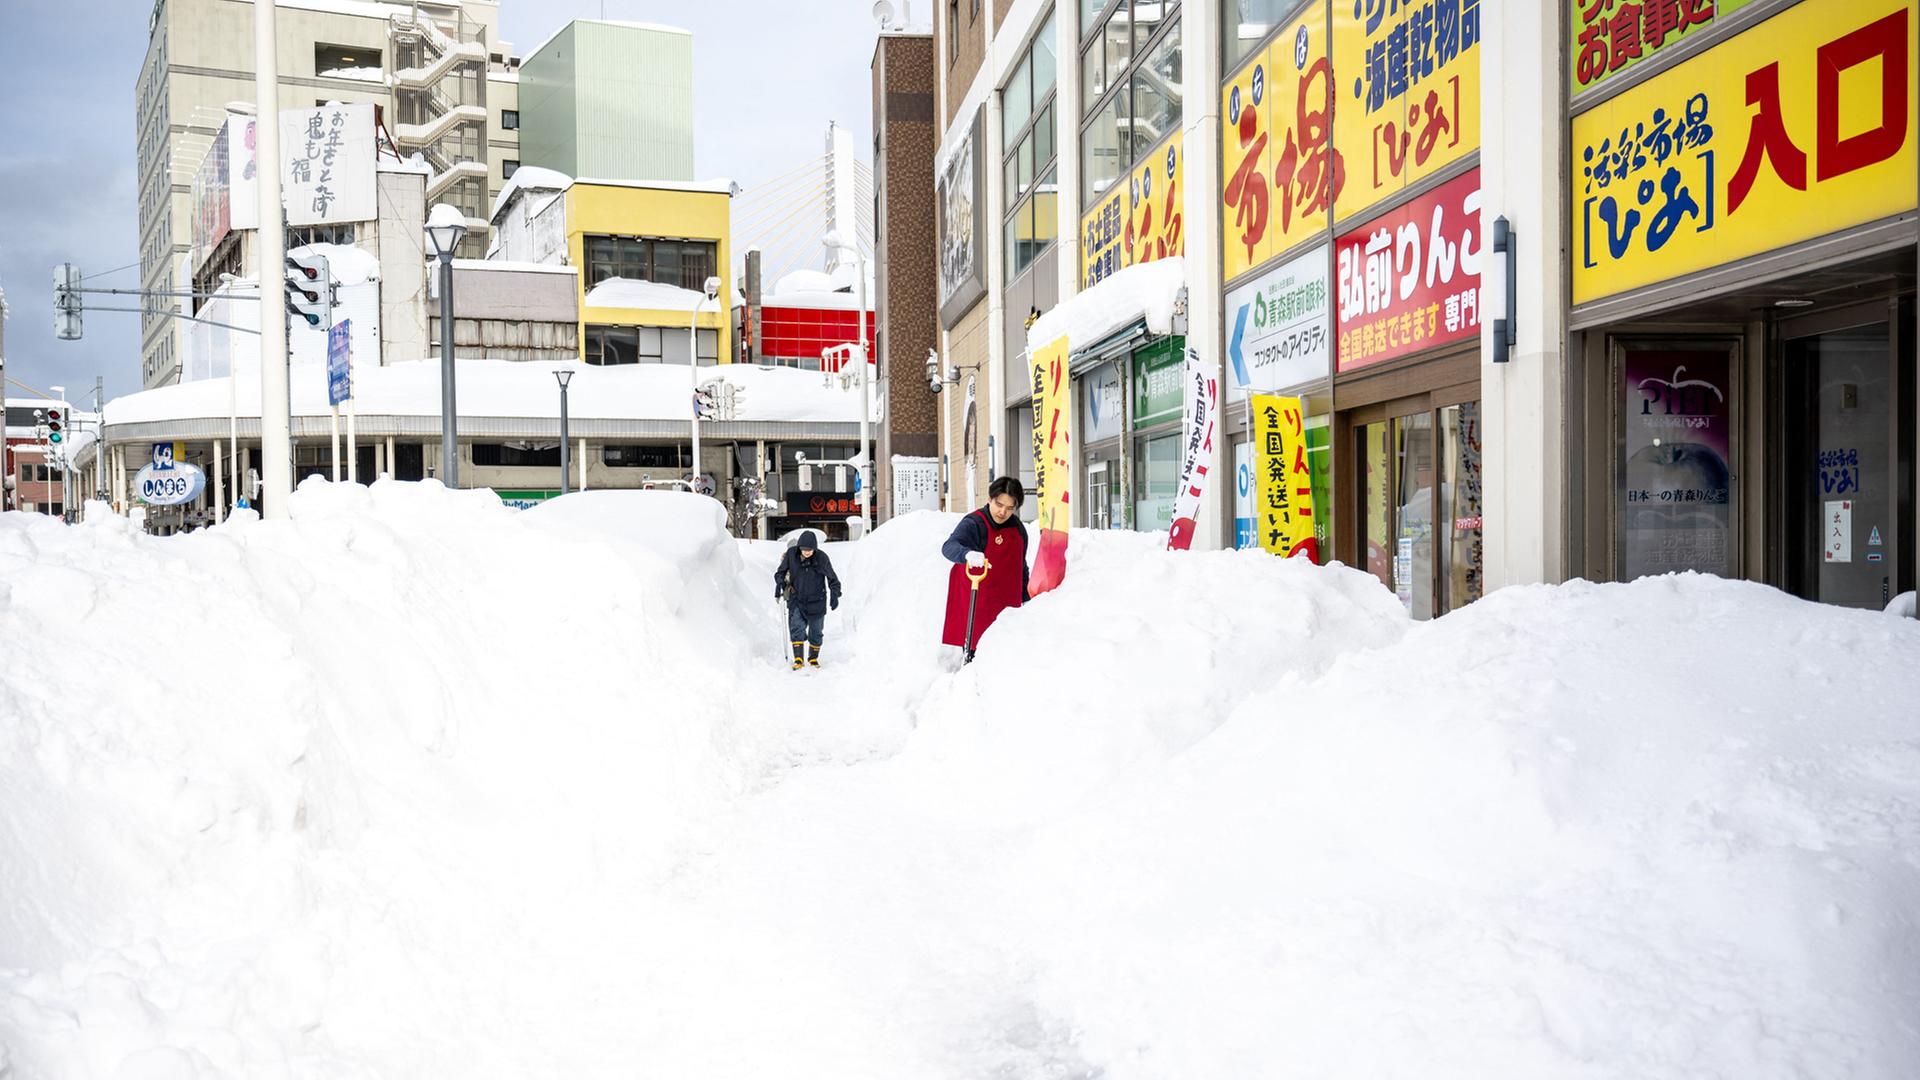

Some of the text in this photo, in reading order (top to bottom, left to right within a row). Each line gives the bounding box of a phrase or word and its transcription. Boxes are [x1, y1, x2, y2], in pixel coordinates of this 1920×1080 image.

[1728, 7, 1909, 217] 入口
[1224, 57, 1346, 265] 市場
[1268, 276, 1326, 328] 青森駅前眼科
[1340, 287, 1481, 364] 全国発送できます 専門
[1254, 325, 1327, 368] コンタクトのアイシティ
[143, 477, 187, 497] しんまち
[1263, 406, 1291, 557] 全国発送いた
[1628, 488, 1728, 503] 日本一の青森りんご
[1833, 511, 1842, 551] 出入口
